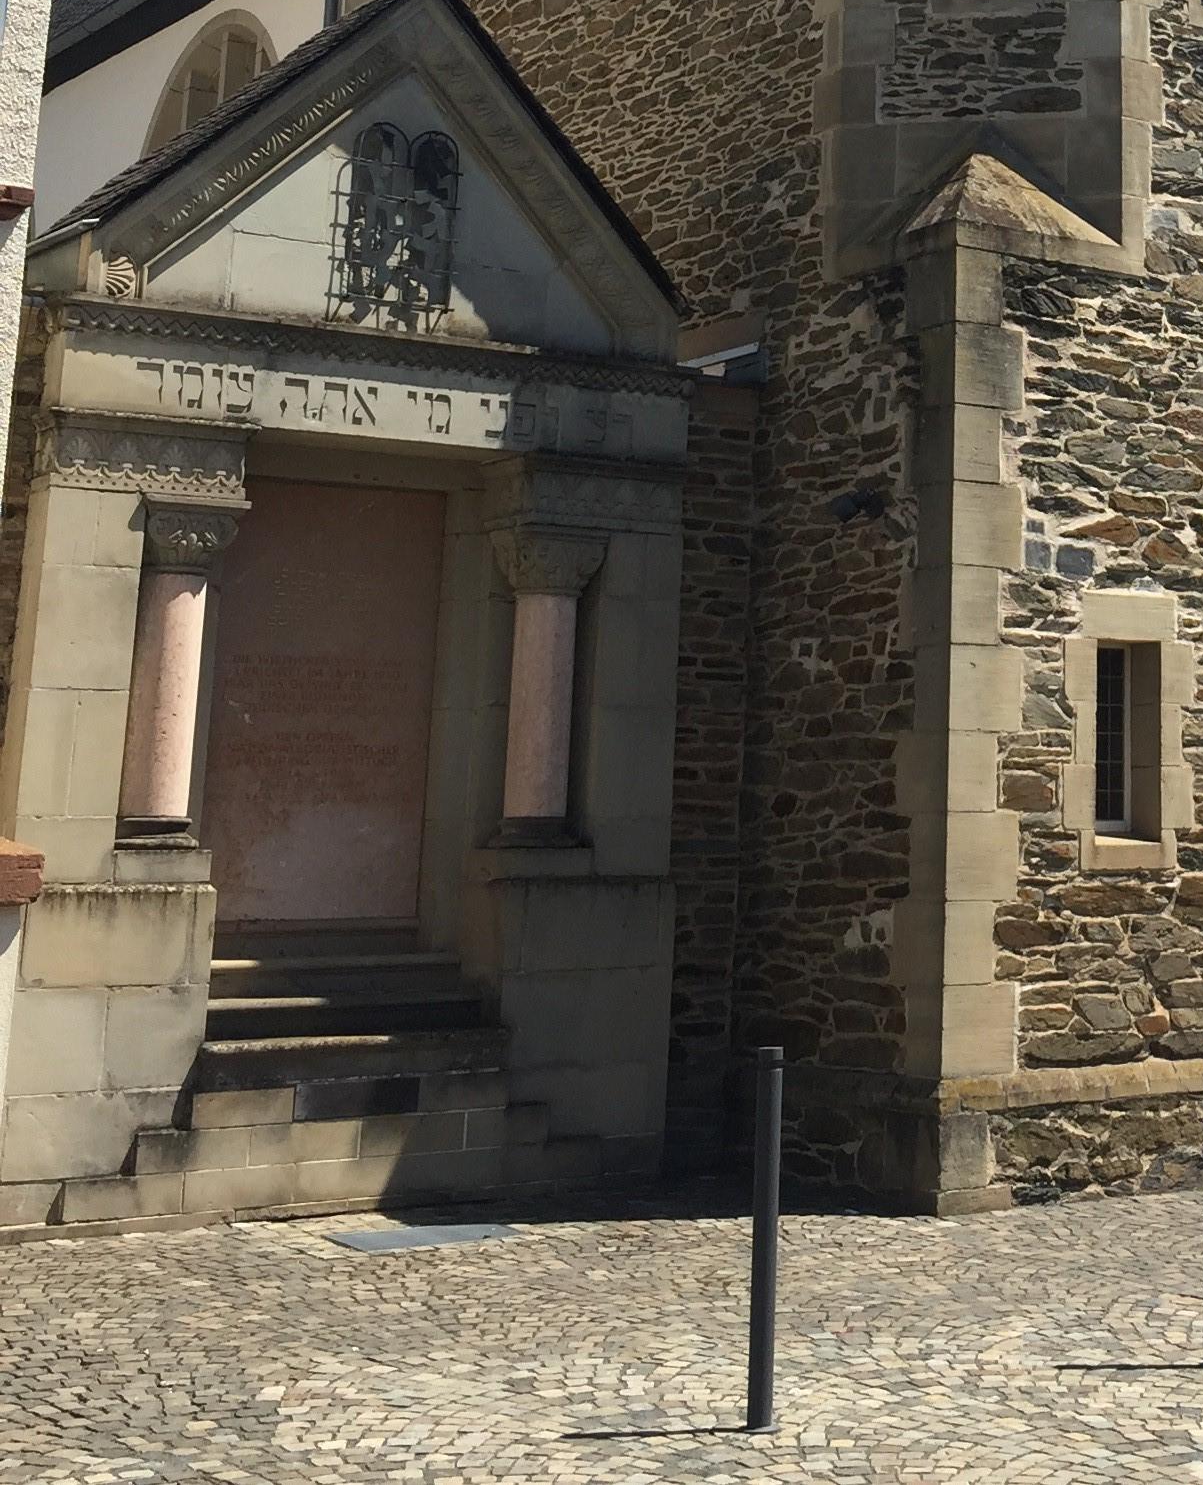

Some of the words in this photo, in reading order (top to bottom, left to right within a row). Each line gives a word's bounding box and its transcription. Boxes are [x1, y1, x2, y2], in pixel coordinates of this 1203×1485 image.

[136, 361, 255, 413] עומד
[279, 377, 378, 426] אתה
[407, 390, 451, 434] מי
